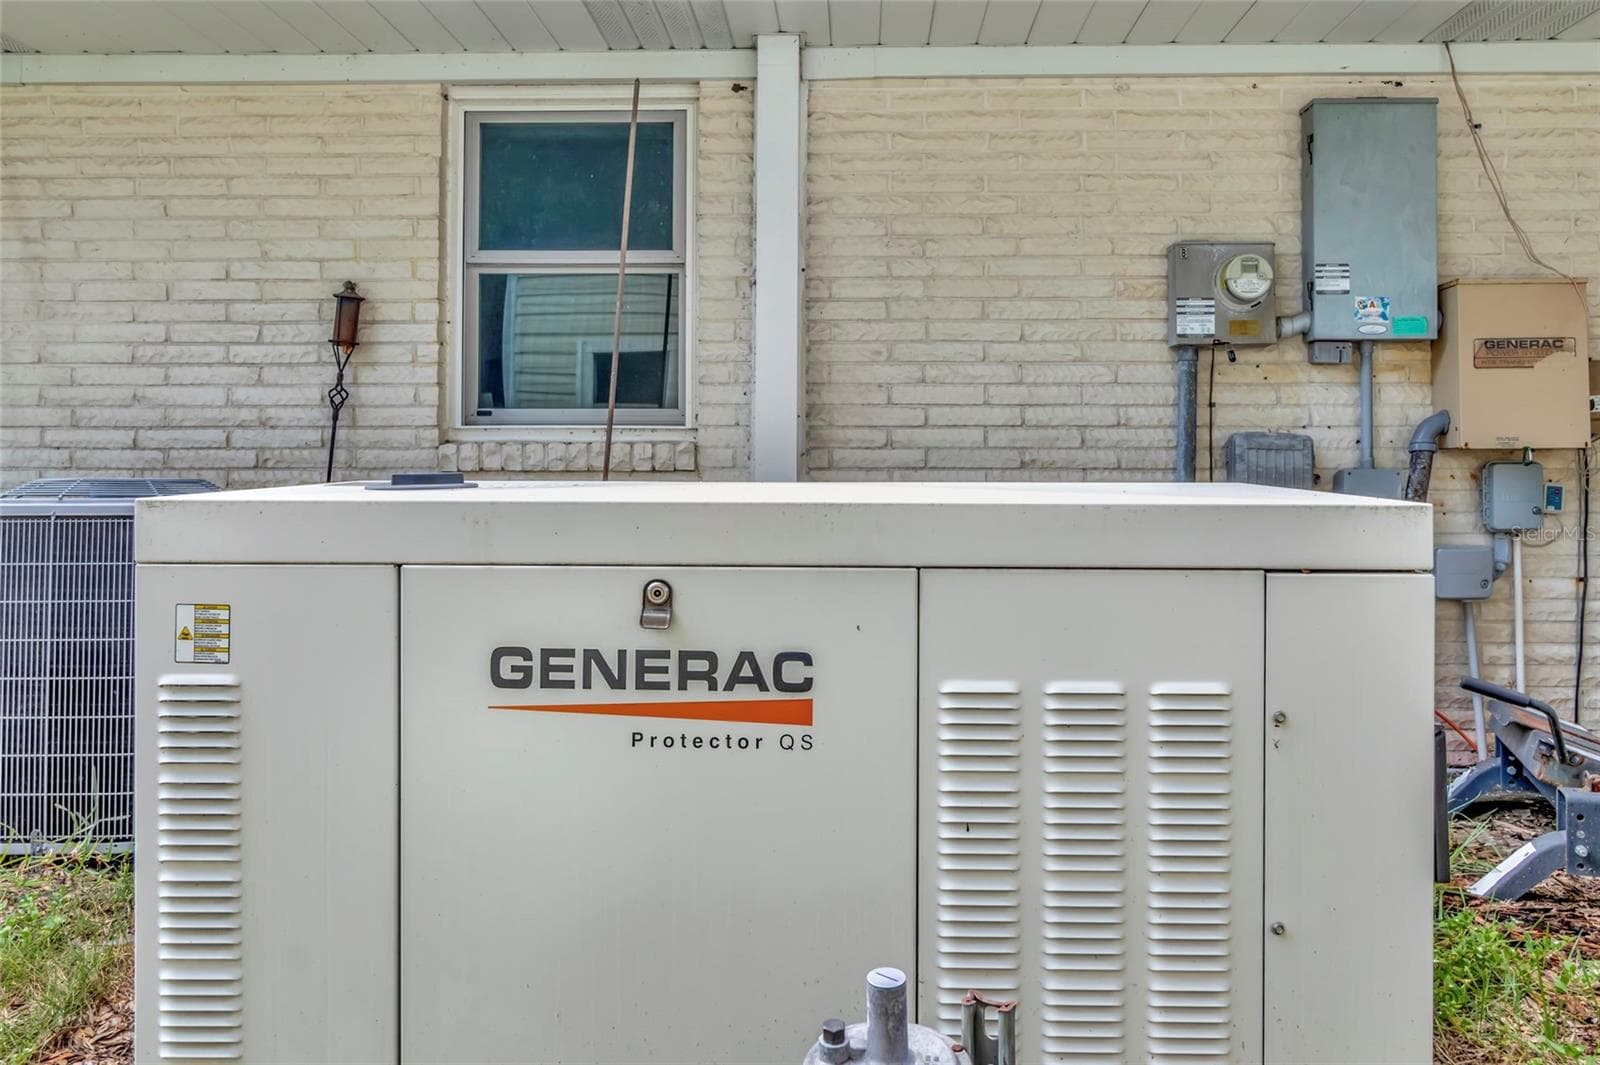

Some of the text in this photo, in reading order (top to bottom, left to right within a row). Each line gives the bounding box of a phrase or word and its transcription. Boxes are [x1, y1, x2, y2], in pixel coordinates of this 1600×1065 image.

[1484, 340, 1564, 349] GENERAC
[490, 646, 813, 693] GENERAC
[631, 731, 813, 752] Protector QS
